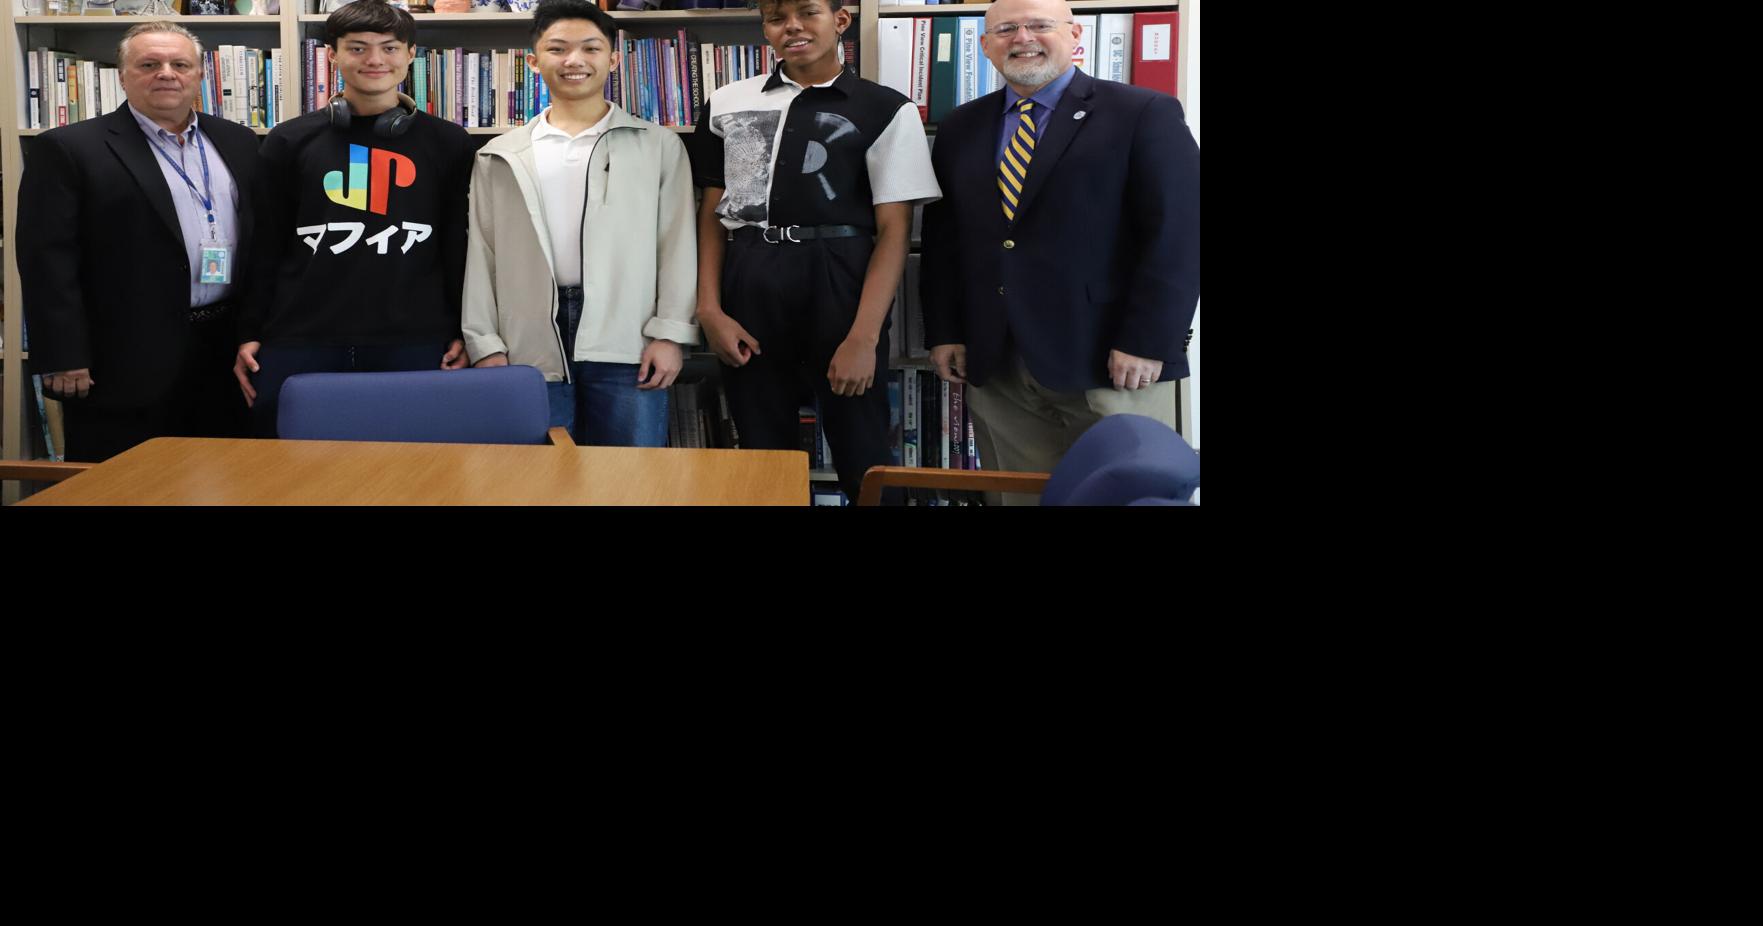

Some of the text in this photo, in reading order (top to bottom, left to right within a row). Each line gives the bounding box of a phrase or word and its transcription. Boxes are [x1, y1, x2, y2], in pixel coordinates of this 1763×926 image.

[690, 54, 698, 78] CREATING
[692, 88, 700, 108] SCHOOL
[323, 143, 417, 216] JP
[296, 221, 433, 255] マフィア
